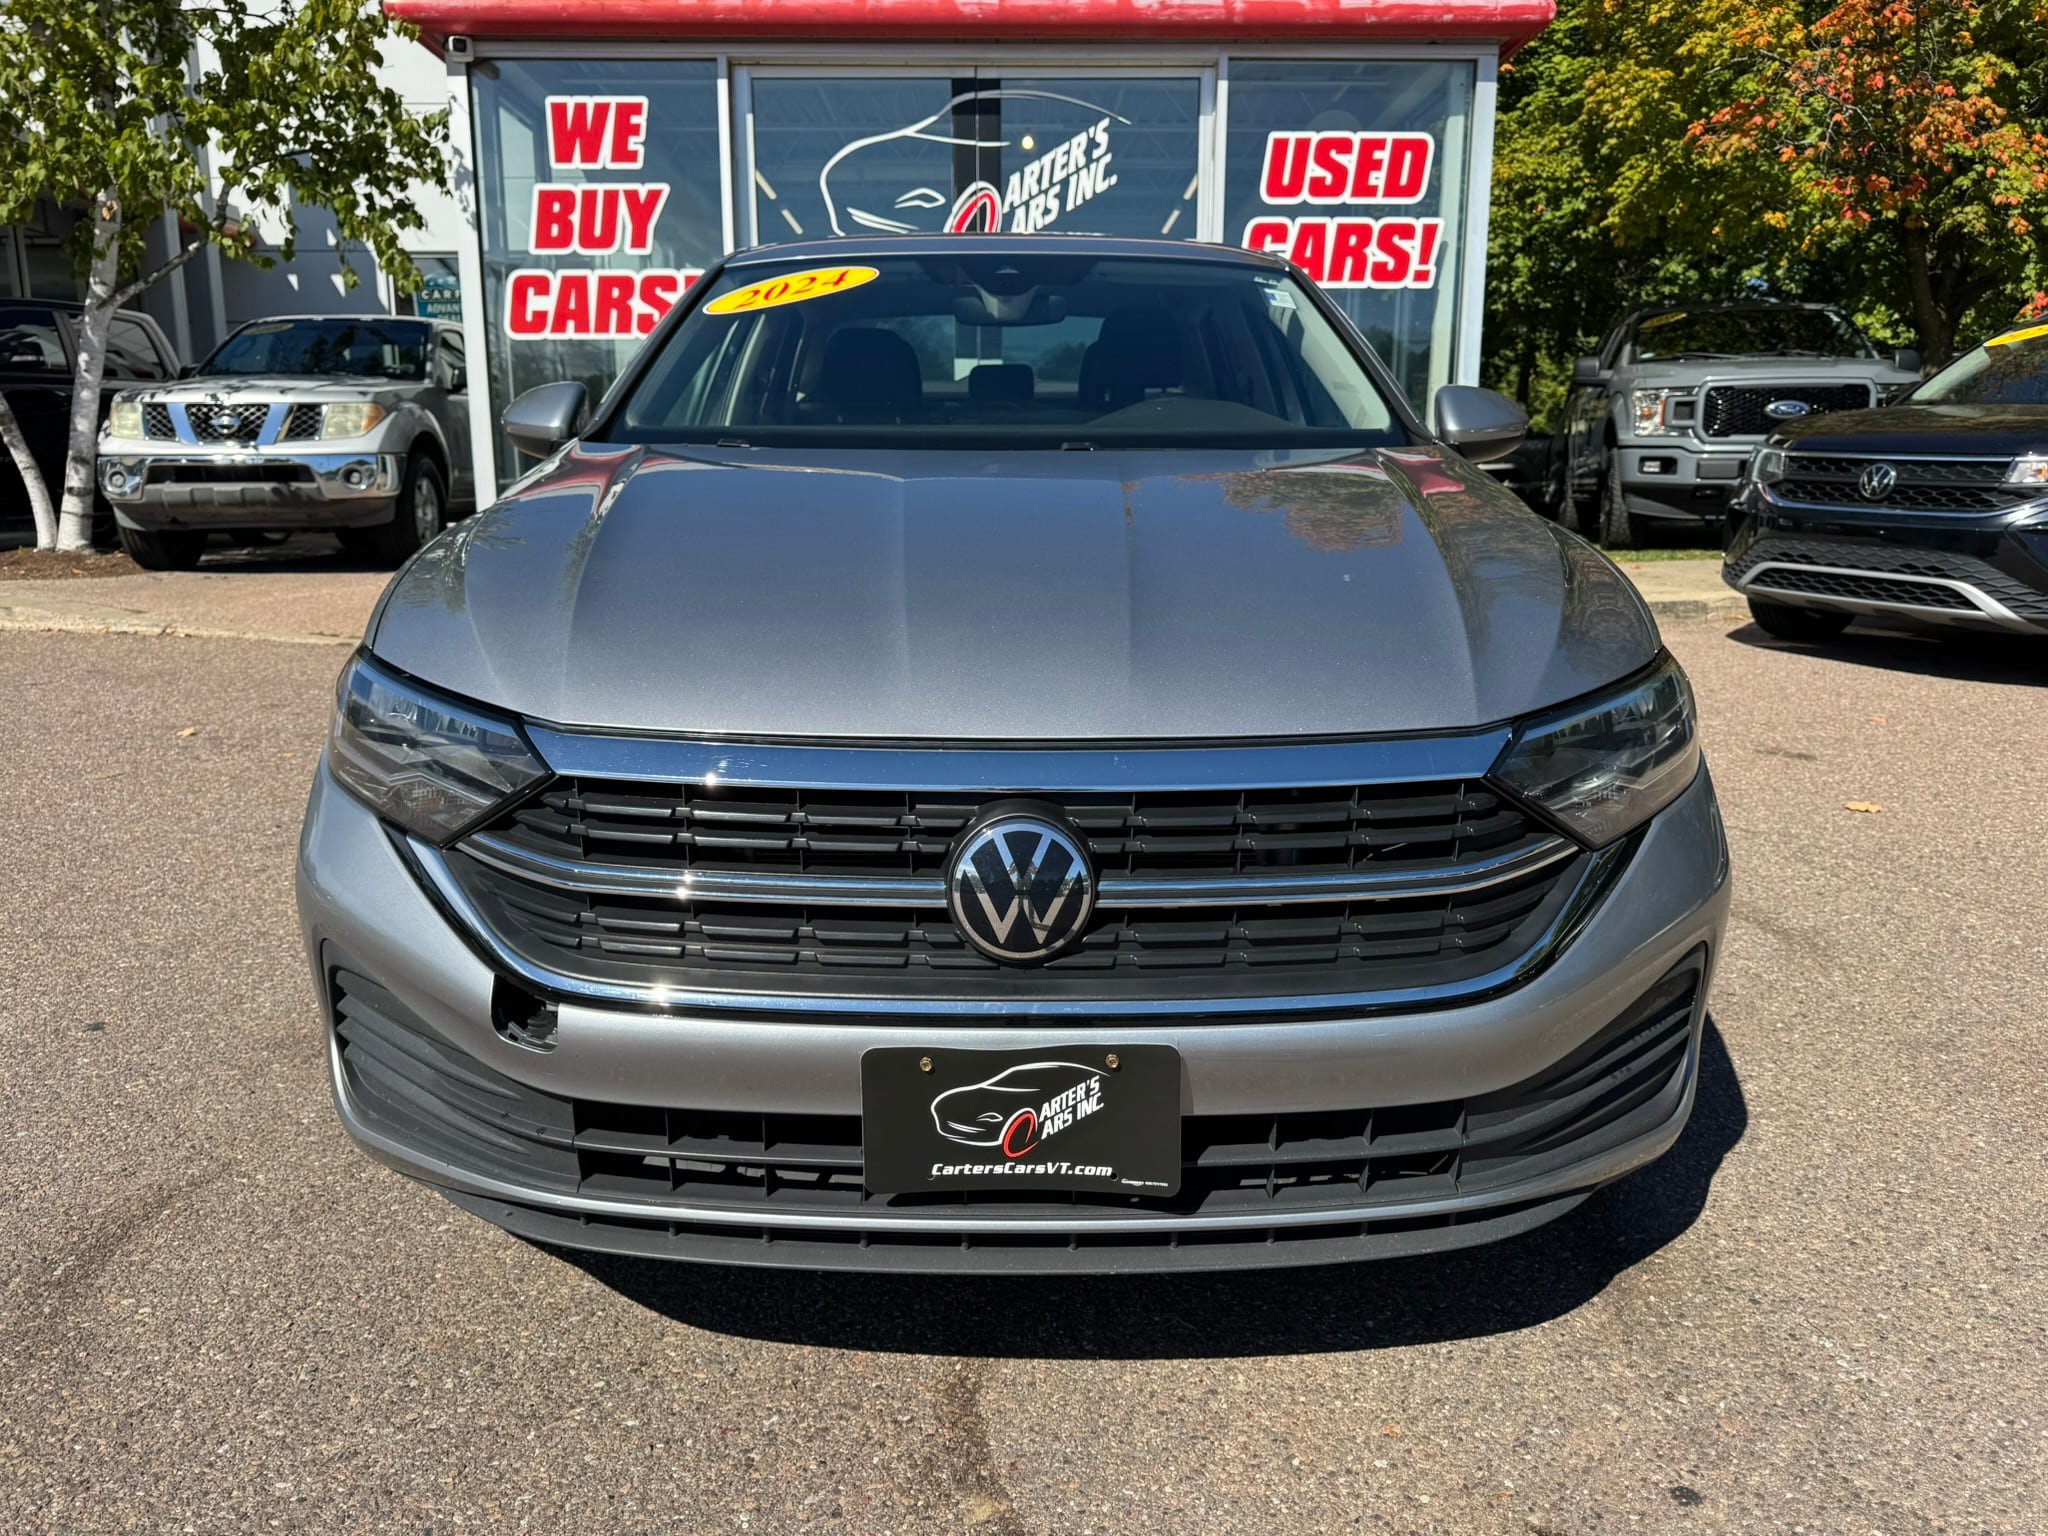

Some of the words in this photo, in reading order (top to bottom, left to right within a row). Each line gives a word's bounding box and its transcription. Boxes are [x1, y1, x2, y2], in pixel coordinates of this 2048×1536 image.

[547, 99, 647, 166] WE
[1066, 152, 1118, 213] INC.
[1262, 134, 1432, 200] USED
[531, 187, 668, 252] BUY
[734, 268, 850, 310] 2024
[931, 1161, 1113, 1177] CartersCarsVT.com
